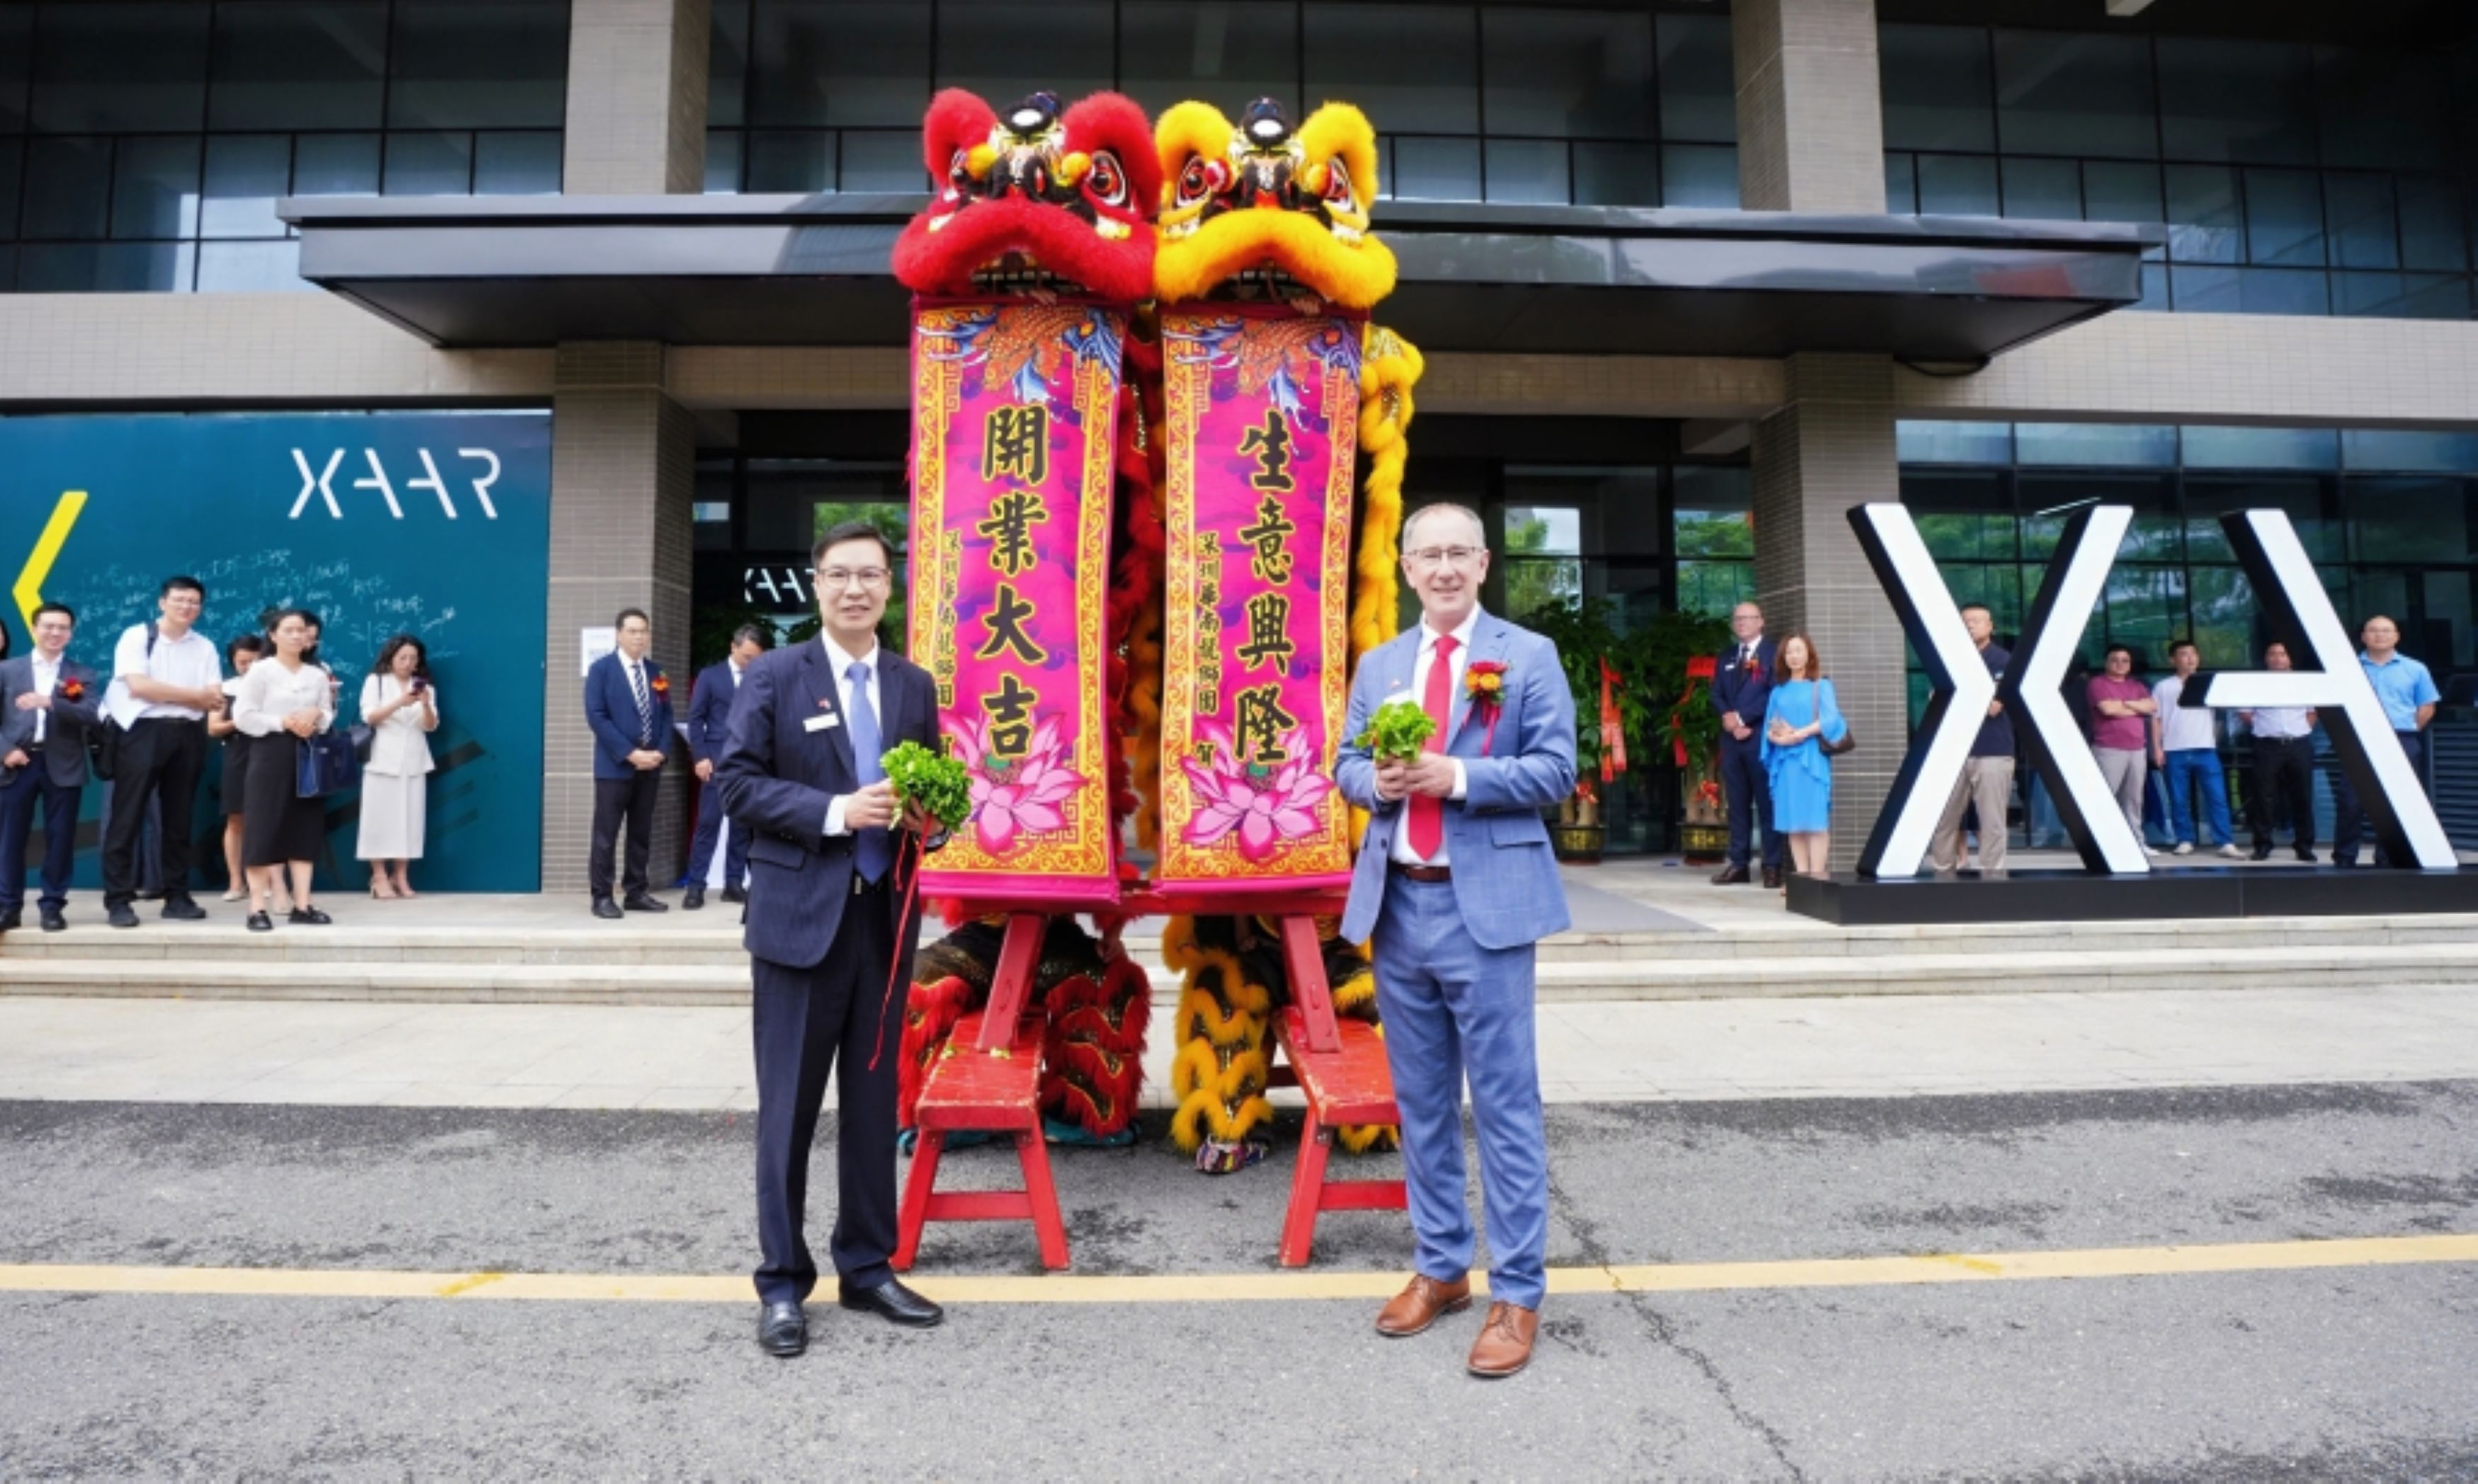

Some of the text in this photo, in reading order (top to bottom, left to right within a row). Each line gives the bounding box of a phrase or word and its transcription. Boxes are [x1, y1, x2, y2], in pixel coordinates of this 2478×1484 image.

[288, 447, 501, 519] XAAR
[976, 404, 1049, 758] 開業大吉
[1236, 409, 1296, 763] 生意興隆
[1846, 503, 2459, 878] XA
